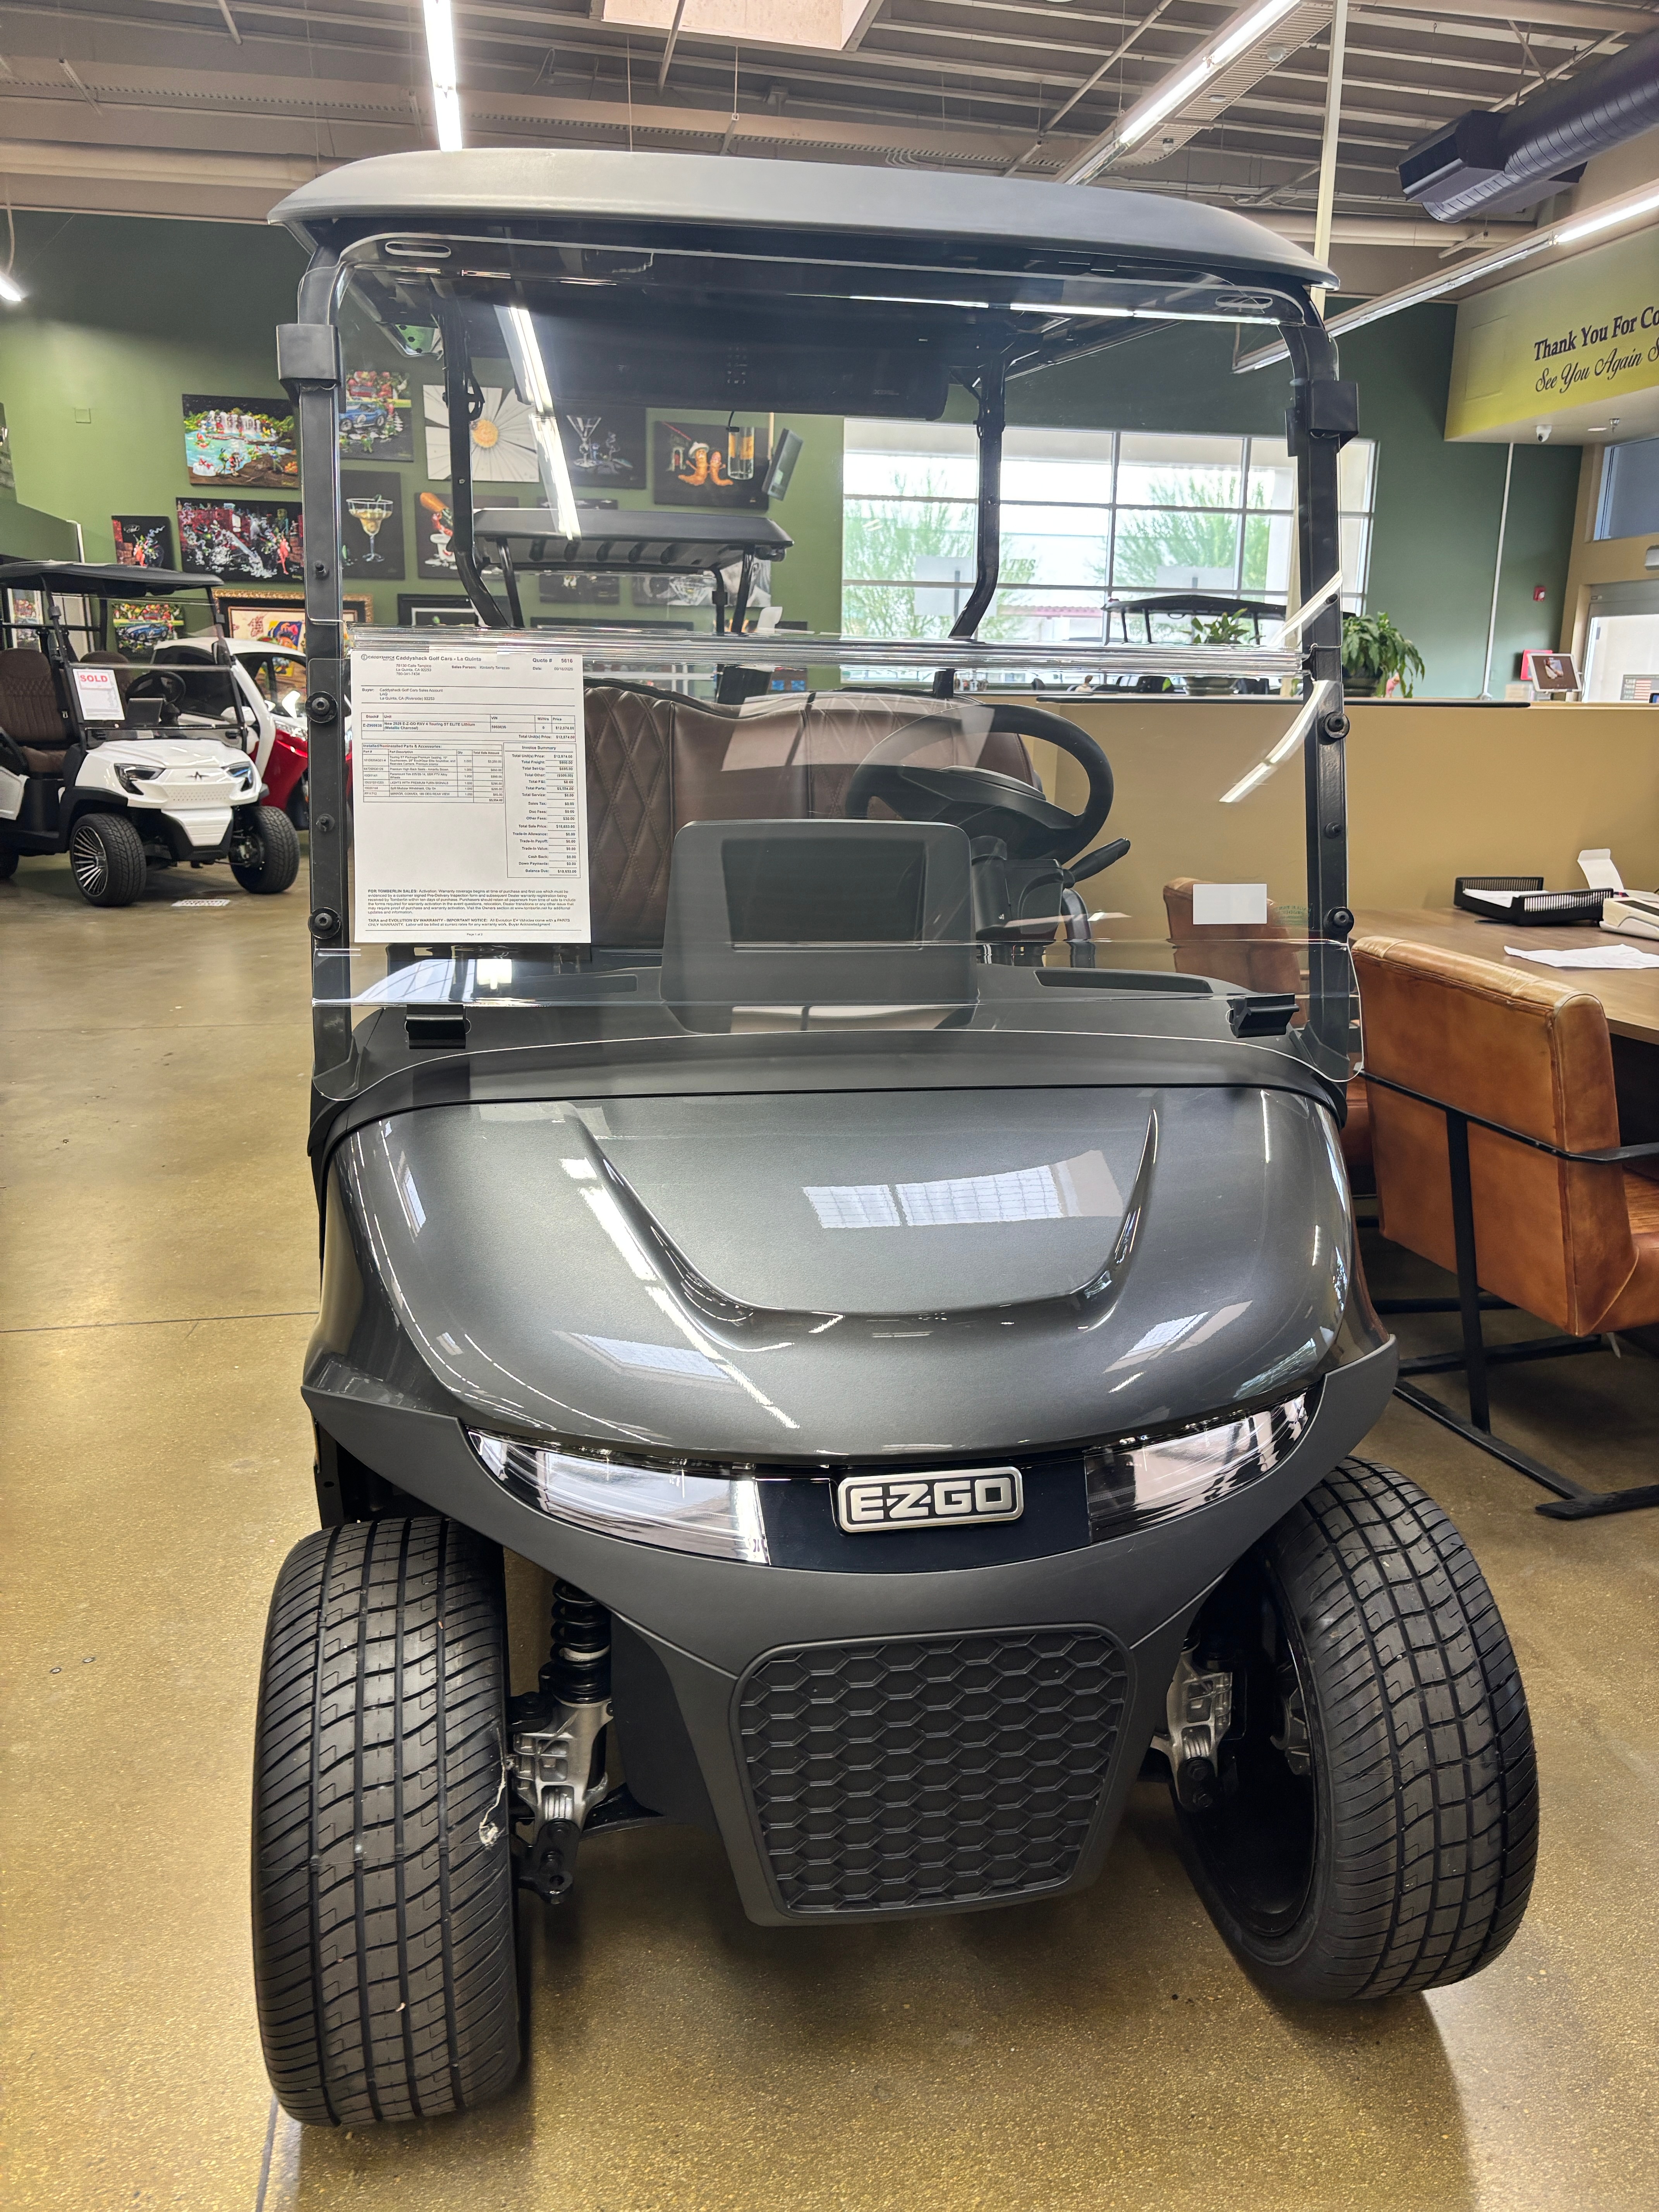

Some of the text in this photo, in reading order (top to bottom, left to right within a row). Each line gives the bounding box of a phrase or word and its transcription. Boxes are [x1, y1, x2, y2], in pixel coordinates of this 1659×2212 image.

[1535, 330, 1577, 361] Thank
[1581, 325, 1608, 347] You
[1611, 316, 1637, 338] For
[1535, 368, 1557, 392] See
[1559, 362, 1590, 393] You
[1594, 348, 1642, 380] Again
